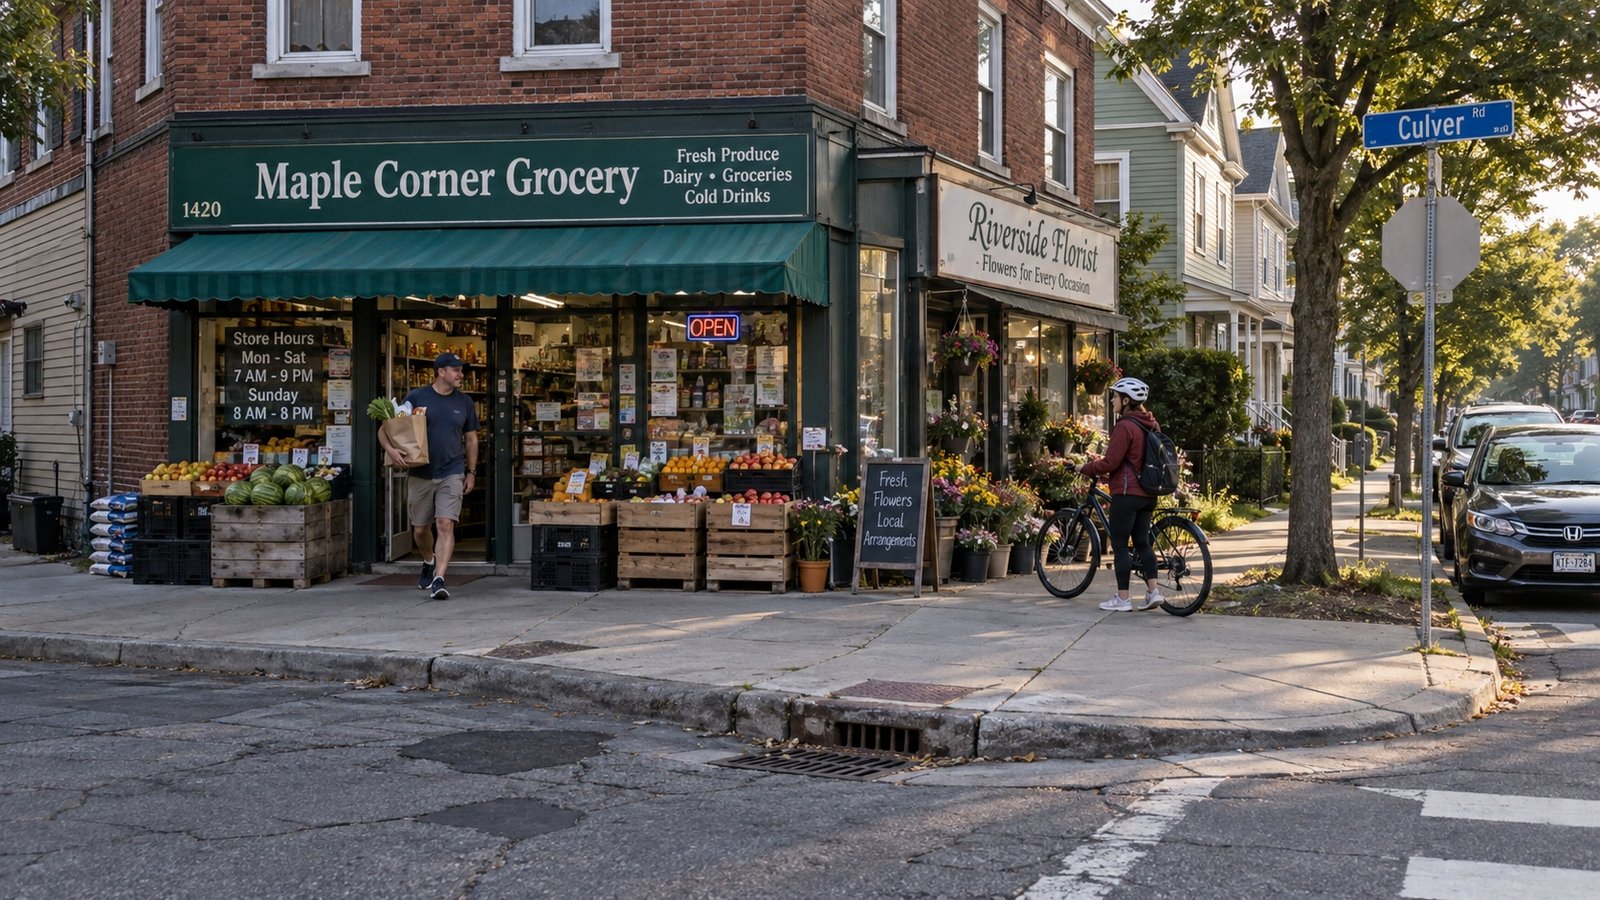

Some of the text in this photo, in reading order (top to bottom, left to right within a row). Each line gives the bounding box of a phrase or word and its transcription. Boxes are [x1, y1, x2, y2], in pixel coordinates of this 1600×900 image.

[1398, 106, 1486, 140] Culver Rd
[678, 146, 780, 163] Fresh Produce
[254, 157, 640, 210] Maple Corner Grocery
[663, 168, 703, 187] Dairy
[722, 167, 793, 183] Groceries
[684, 187, 771, 205] Cold Drinks
[182, 201, 222, 218] 1420
[968, 201, 1099, 273] Riverside Florist
[982, 253, 1018, 279] Flowers
[1019, 262, 1033, 282] for
[1034, 266, 1057, 290] Every
[1058, 272, 1091, 296] Occasion
[690, 318, 736, 337] OPEN
[233, 331, 315, 346] Store Hours
[241, 350, 271, 365] Mon
[283, 350, 307, 364] Sat
[234, 369, 242, 383] 7
[245, 369, 267, 383] AM
[280, 369, 289, 383] 9
[292, 369, 313, 383] PM
[248, 388, 299, 405] Sunday
[233, 406, 242, 420] 8
[245, 406, 267, 420] AM
[280, 406, 289, 420] 8
[292, 406, 313, 420] PM
[879, 470, 909, 488] Fresh
[873, 490, 913, 507] Flowers
[877, 512, 905, 528] Local
